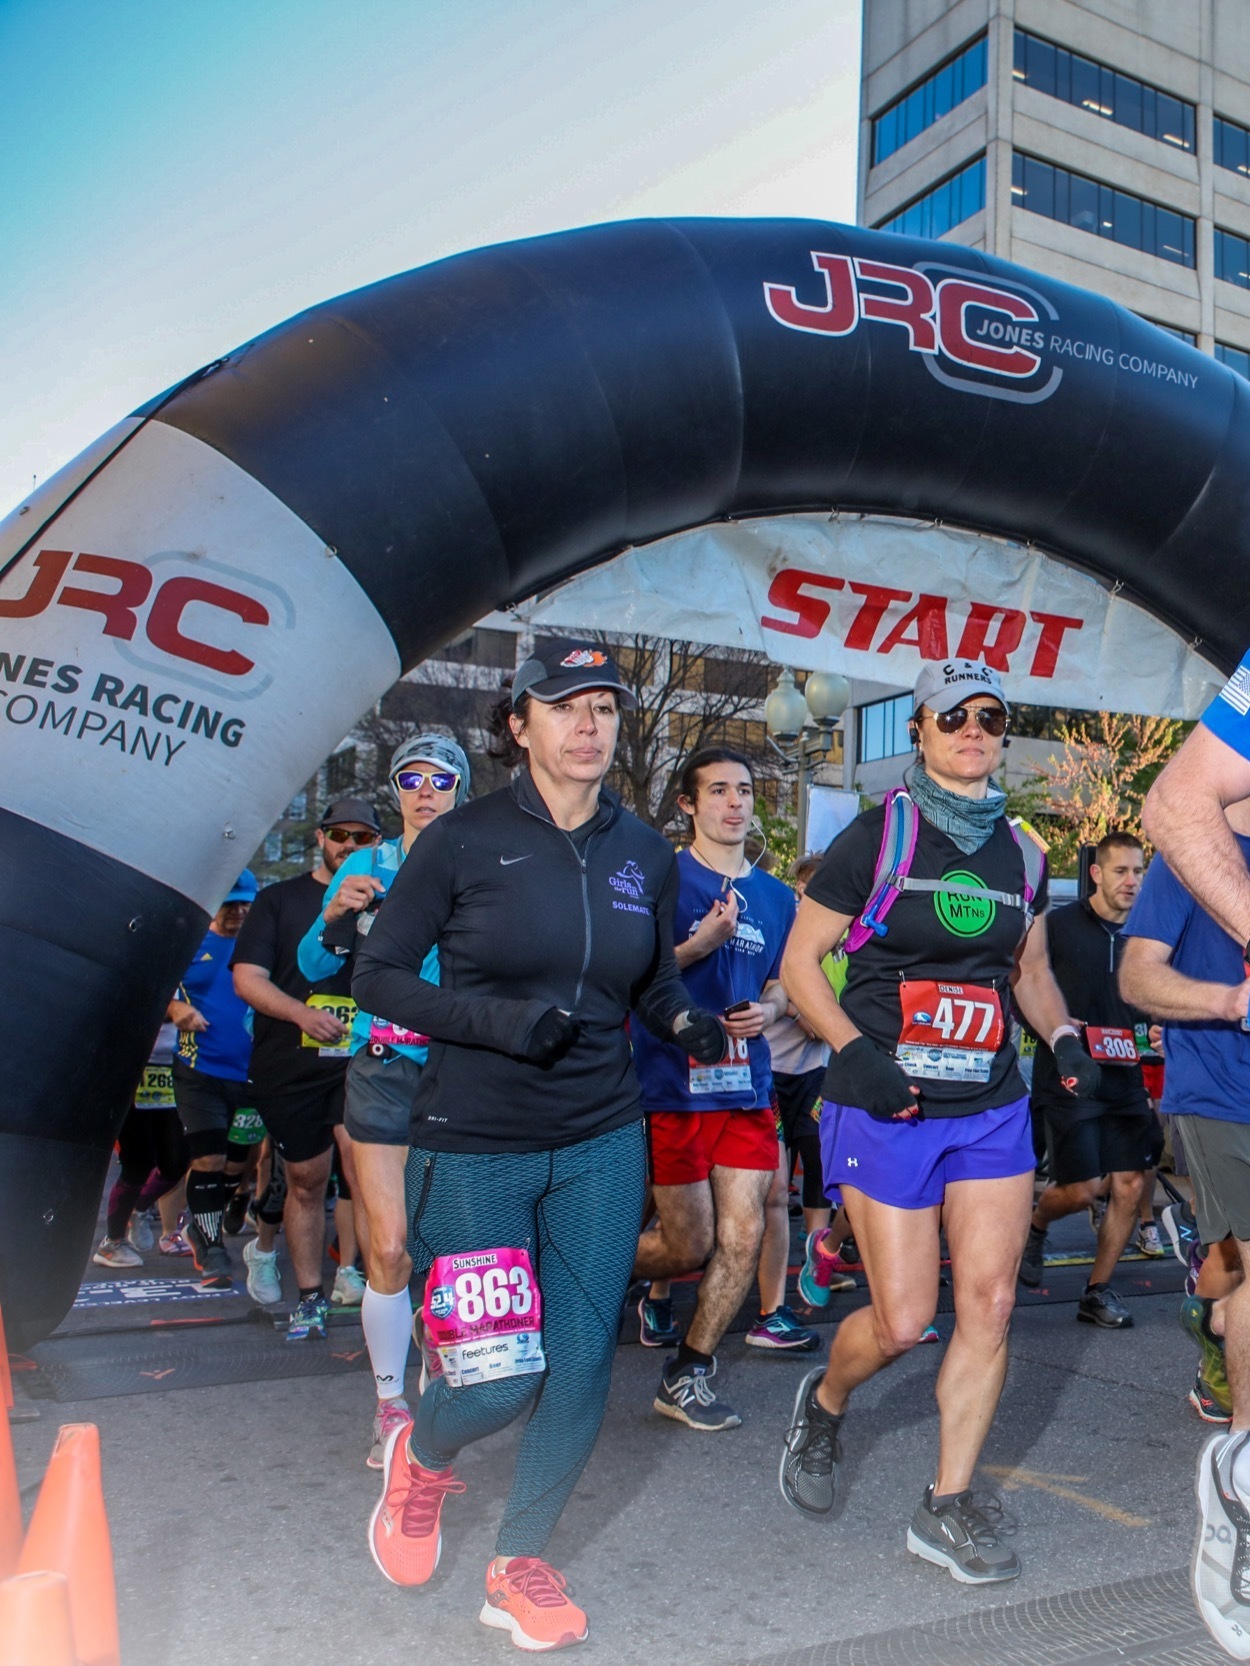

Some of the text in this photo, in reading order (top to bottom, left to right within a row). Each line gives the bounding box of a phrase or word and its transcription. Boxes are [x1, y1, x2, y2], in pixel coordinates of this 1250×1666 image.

[763, 251, 1041, 378] JRC
[976, 318, 1198, 390] JONES RACING COMPANY
[0, 549, 270, 676] JRC
[761, 568, 1084, 679] START
[0, 652, 246, 748] NES RACING
[944, 673, 992, 685] RUNNERS
[0, 690, 186, 767] OMPANY
[932, 997, 995, 1043] 477
[1103, 1036, 1137, 1059] 306
[453, 1254, 497, 1270] SUNSHINE
[455, 1266, 533, 1324] 863
[462, 1342, 509, 1360] feetures
[469, 1316, 535, 1333] MARATHONER
